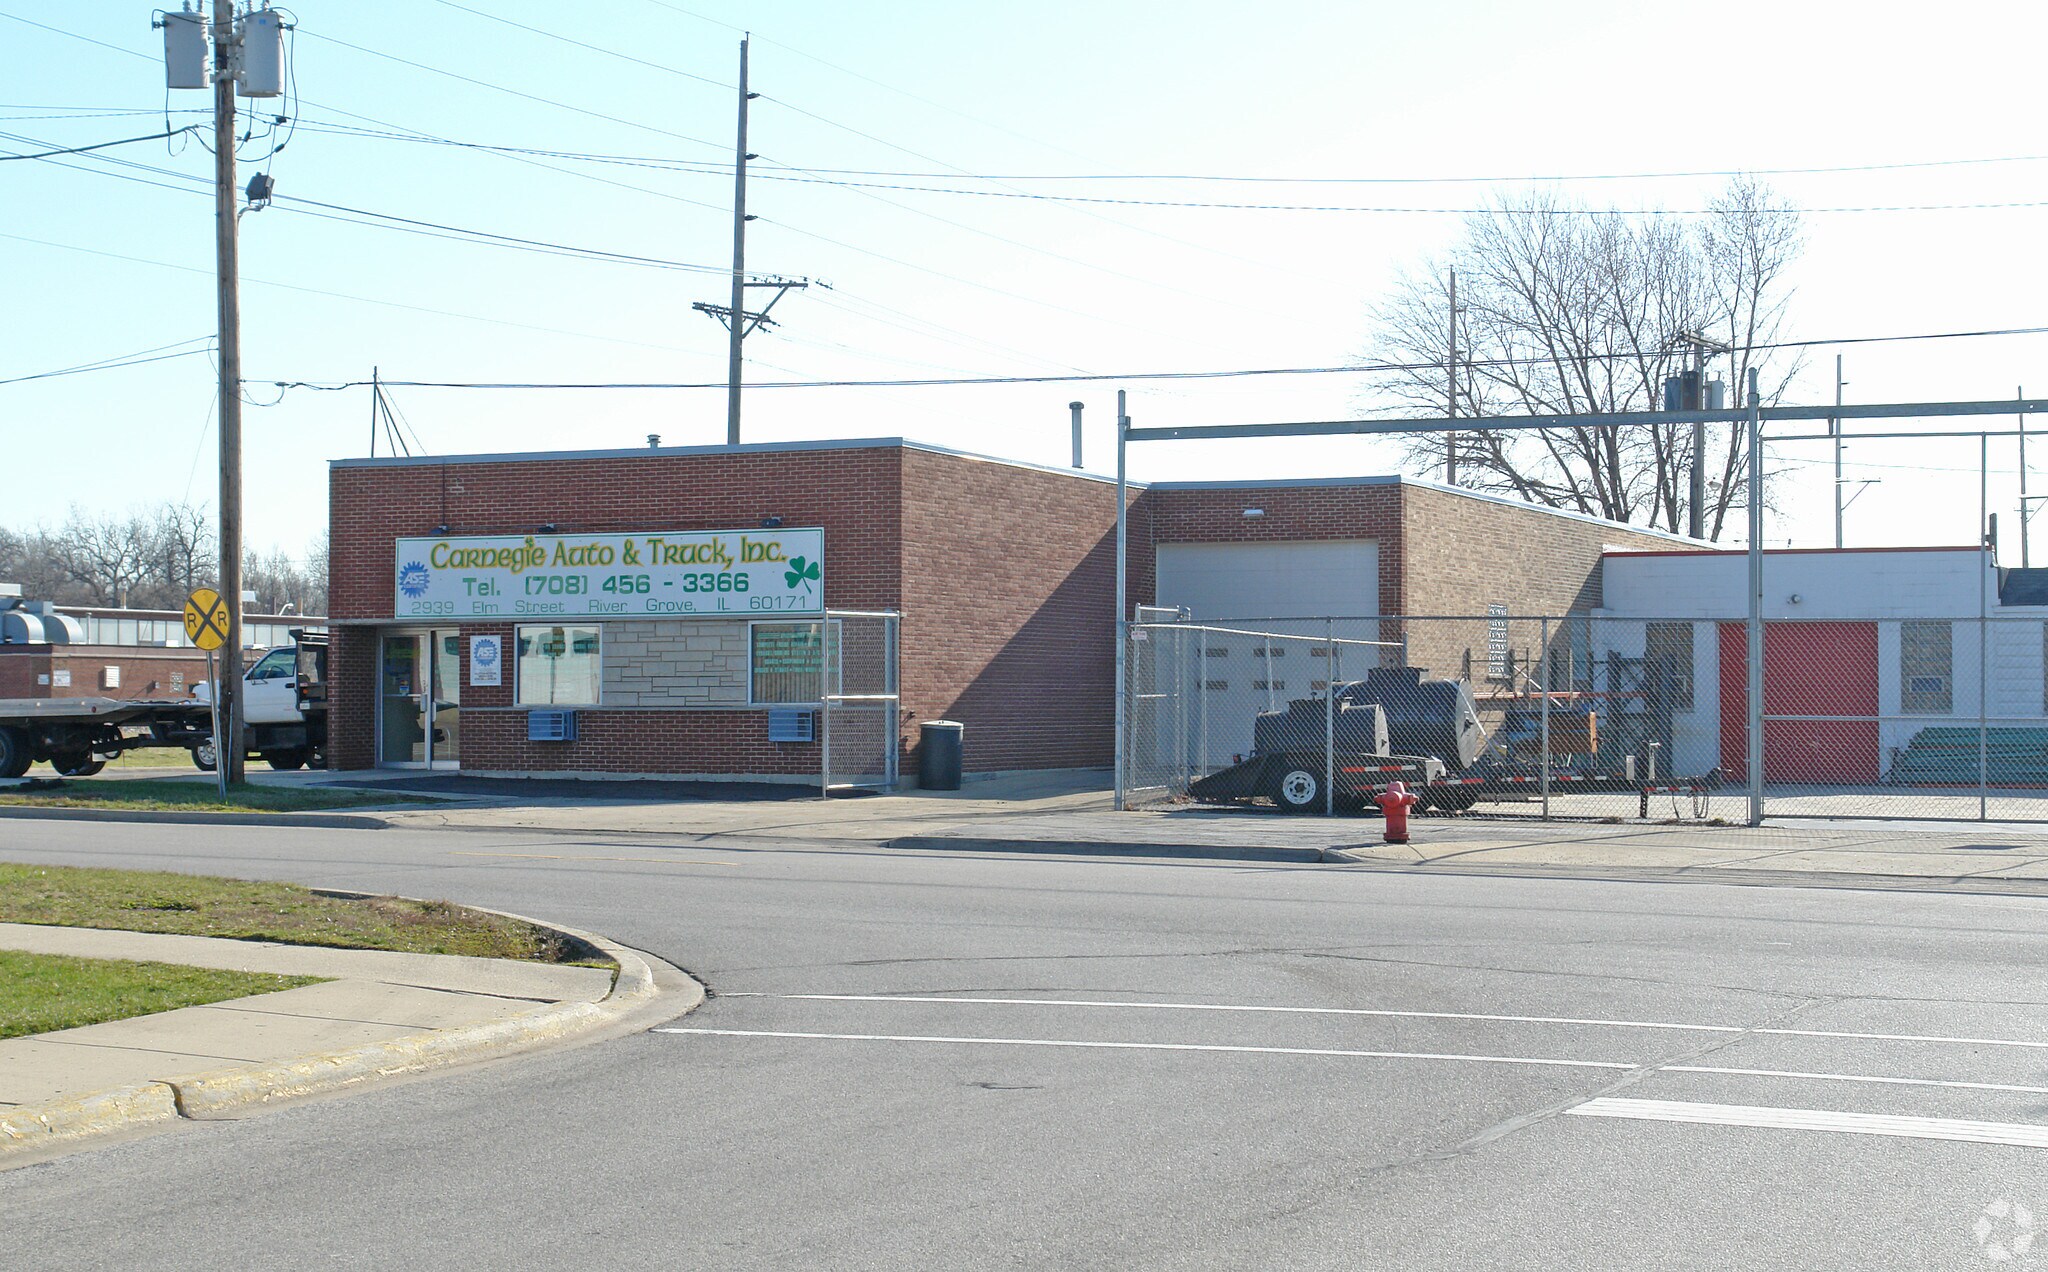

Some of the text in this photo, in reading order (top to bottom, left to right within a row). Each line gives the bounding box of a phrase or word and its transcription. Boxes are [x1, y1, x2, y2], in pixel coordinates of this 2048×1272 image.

[430, 535, 789, 574] Carnegie Auto & Truck, Inc.
[403, 572, 424, 584] ASE
[462, 577, 500, 596] Tel.
[602, 574, 650, 594] 456
[682, 572, 749, 593] 3366
[411, 601, 454, 615] 2939
[472, 601, 499, 614] Elm
[515, 600, 565, 613] Street
[646, 598, 697, 612] Grove,
[717, 597, 731, 610] IL
[750, 595, 806, 610] 60171
[187, 611, 228, 628] R R
